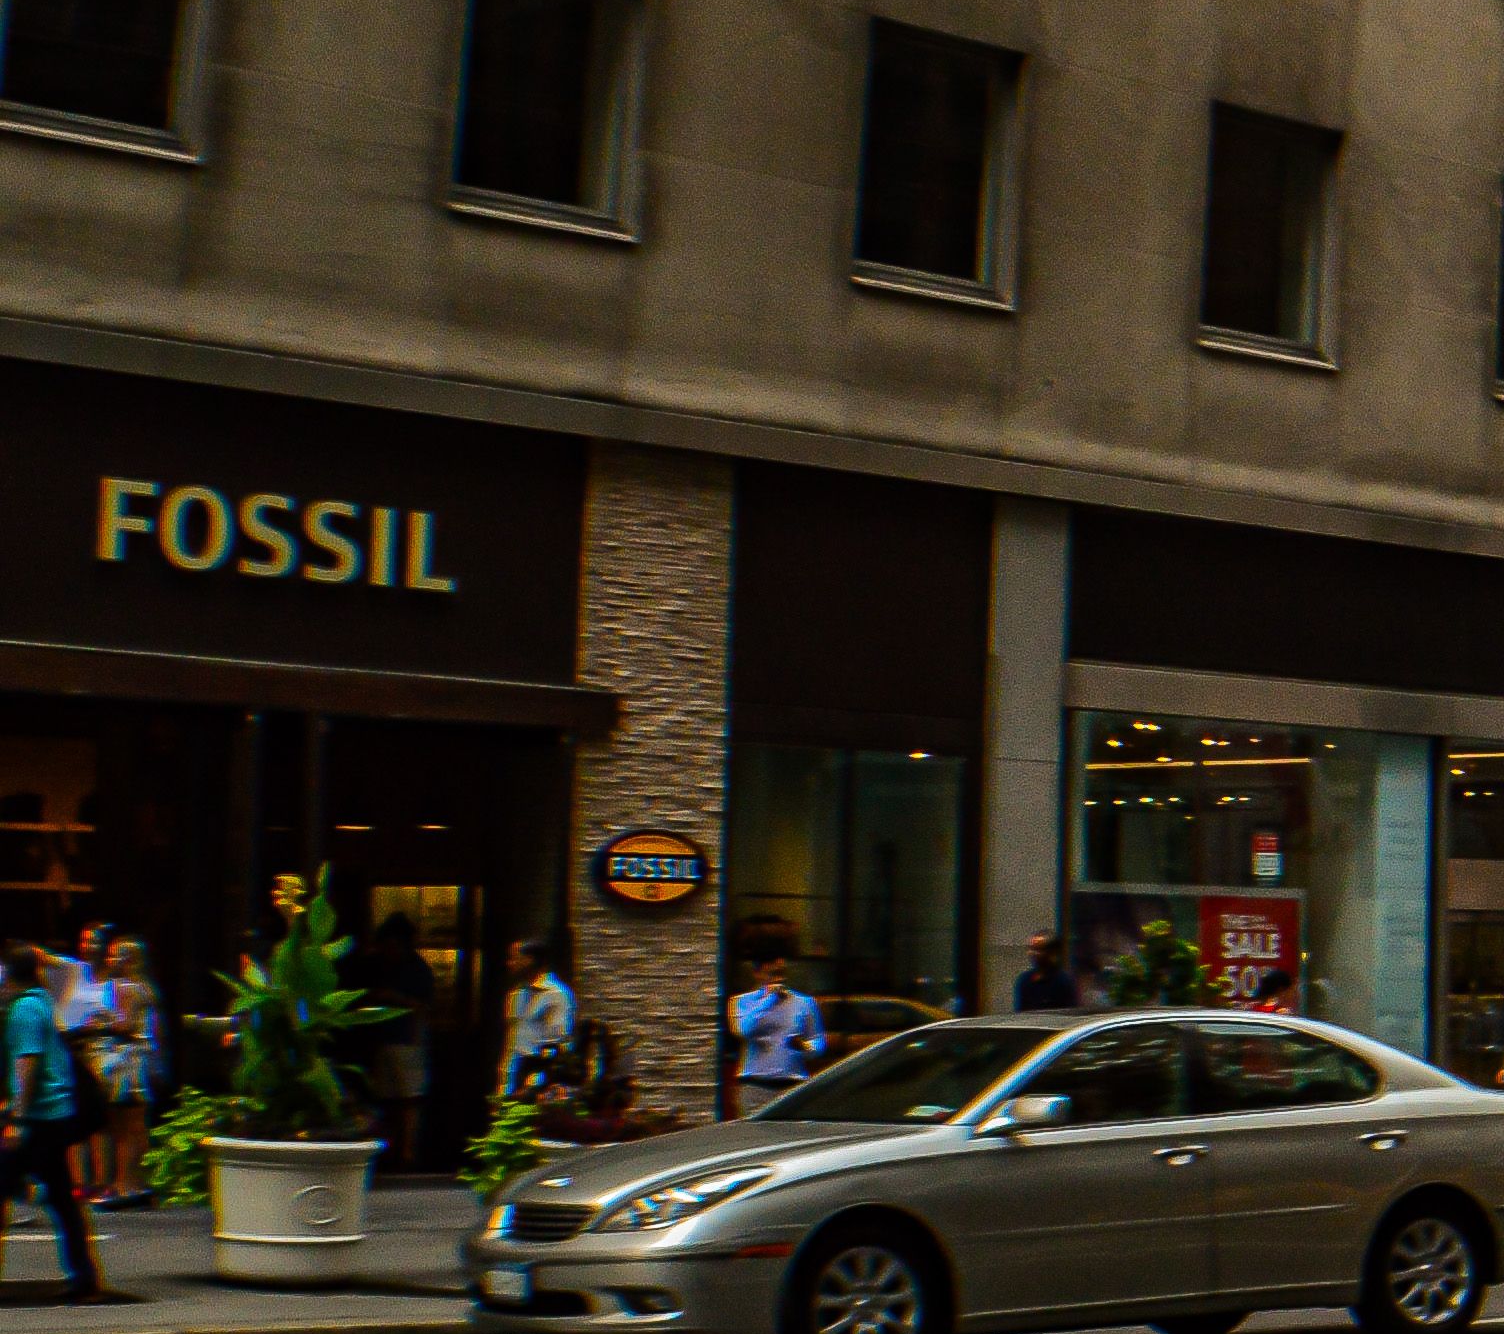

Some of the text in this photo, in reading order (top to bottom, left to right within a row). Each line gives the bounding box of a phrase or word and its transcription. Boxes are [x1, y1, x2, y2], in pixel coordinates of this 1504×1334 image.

[95, 475, 458, 593] FOSSIL
[608, 857, 702, 879] FOSSIL
[1220, 932, 1281, 959] SALE
